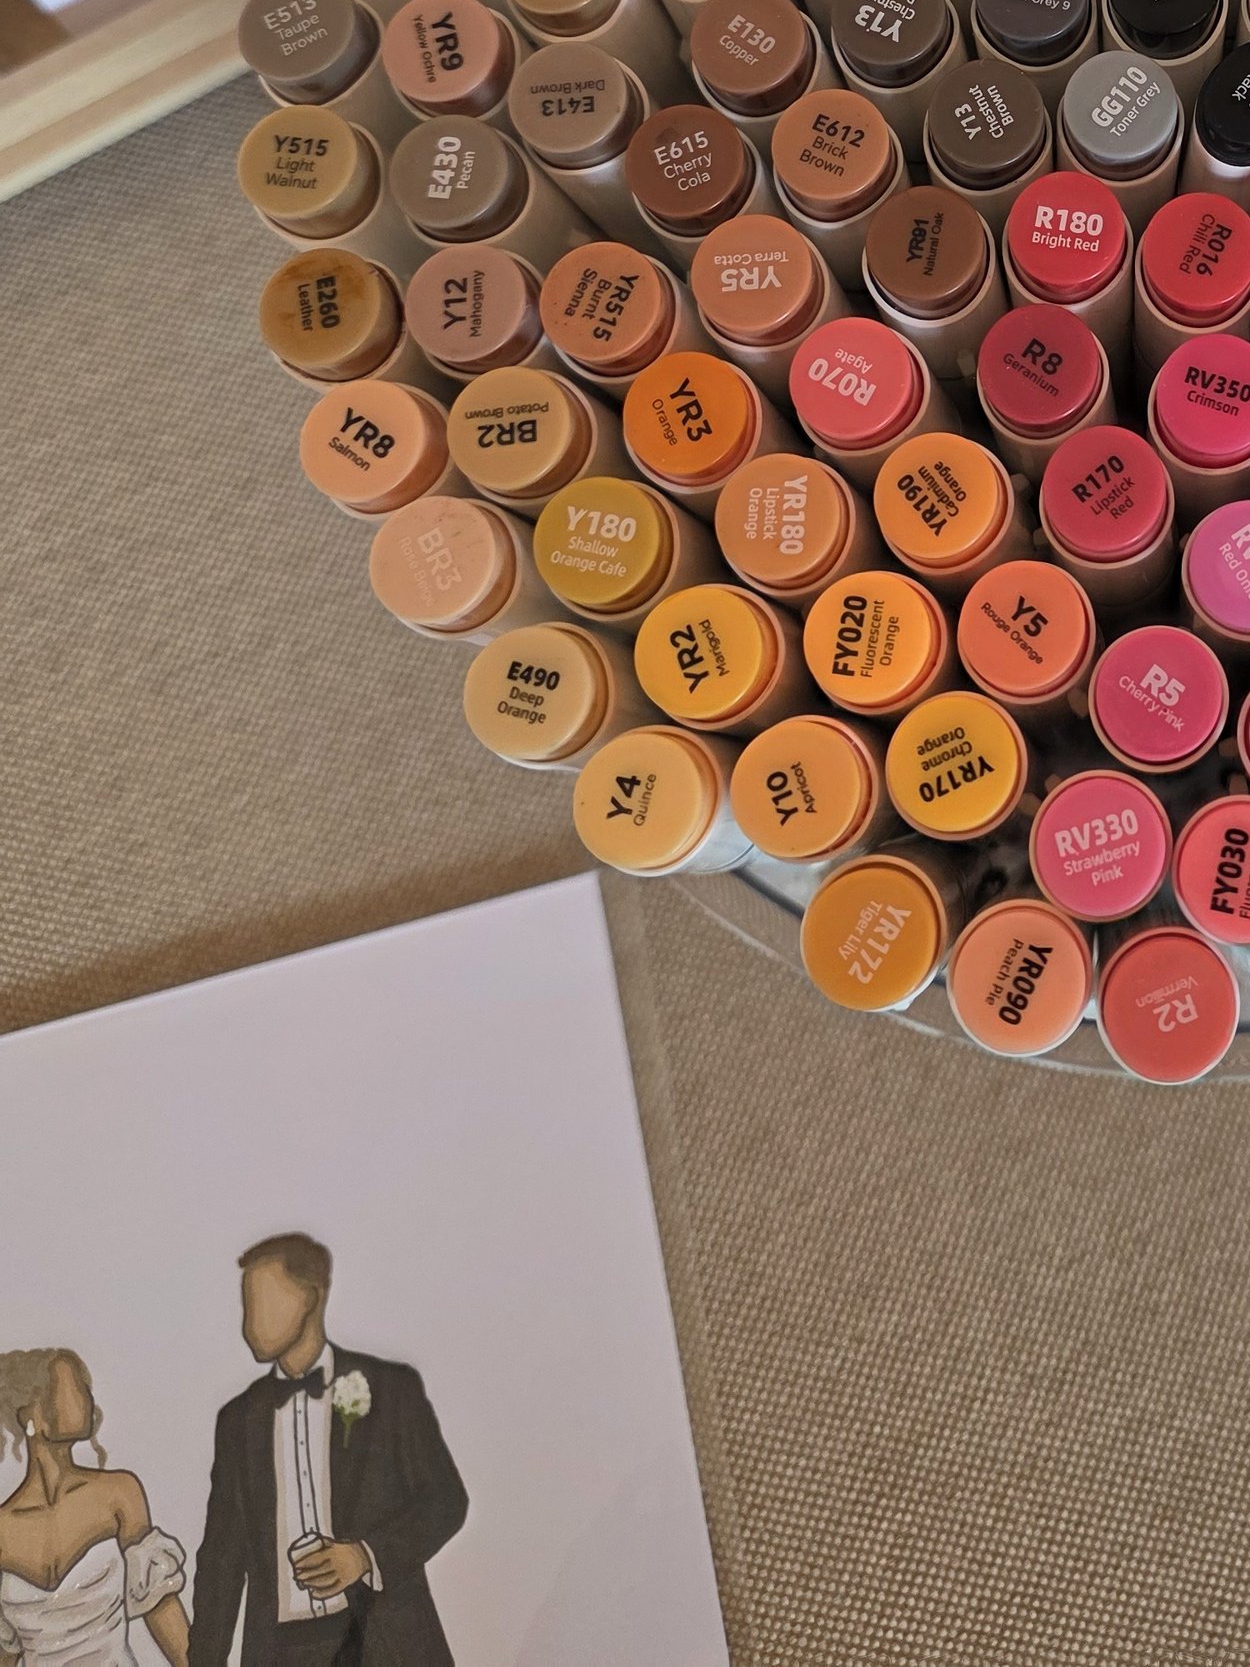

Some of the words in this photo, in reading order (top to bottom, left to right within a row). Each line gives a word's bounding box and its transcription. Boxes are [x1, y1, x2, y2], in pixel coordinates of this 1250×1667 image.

[431, 12, 463, 70] YR9
[530, 80, 573, 95] Brown
[575, 79, 605, 92] Dark
[542, 96, 594, 117] E413
[275, 135, 329, 156] Y515
[812, 114, 864, 150] E612
[276, 157, 316, 174] Light
[654, 131, 711, 168] E615
[799, 149, 845, 176] Brown
[812, 138, 848, 161] Brick
[266, 172, 318, 189] Walnut
[428, 137, 461, 199] E430
[456, 151, 475, 189] Pecan
[1035, 206, 1103, 236] R180
[1032, 232, 1071, 248] Bright
[1074, 237, 1100, 253] Red
[443, 278, 467, 329] Y12
[469, 270, 485, 337] Mahogany
[1021, 338, 1062, 377] R8
[670, 378, 712, 441] YR3
[1187, 390, 1239, 416] Crimson
[340, 407, 395, 458] YR8
[478, 420, 537, 448] BR2
[652, 399, 677, 446] Orange
[329, 437, 370, 471] Salmon
[1072, 456, 1128, 502] R170
[568, 506, 636, 542] Y180
[507, 661, 560, 690] E490
[497, 701, 546, 724] Orange
[509, 686, 544, 708] Deep
[607, 776, 641, 819] Y4
[1055, 809, 1138, 857] RV330
